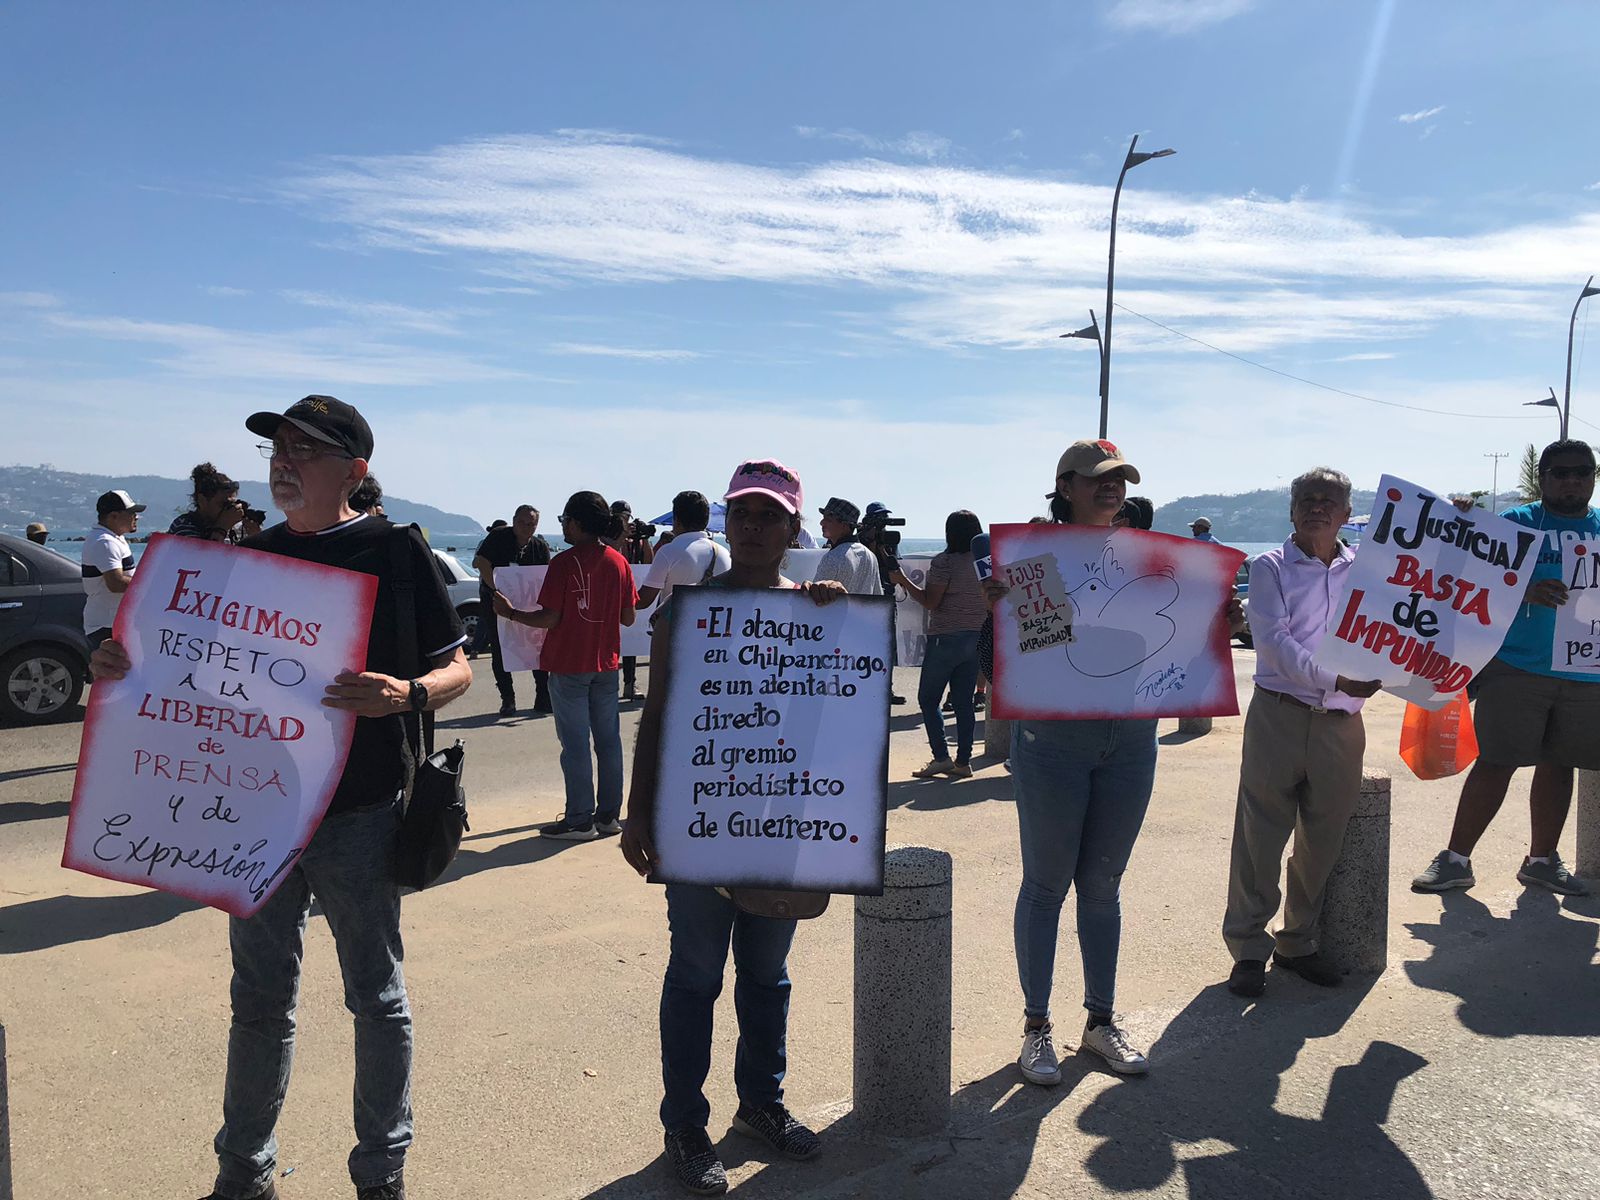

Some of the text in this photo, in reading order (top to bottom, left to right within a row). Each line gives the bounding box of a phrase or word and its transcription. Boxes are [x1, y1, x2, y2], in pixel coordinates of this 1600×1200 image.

[165, 568, 322, 647] EXIGIMOS
[1021, 581, 1045, 599] TI
[1387, 554, 1491, 626] BASTA
[742, 608, 825, 646] ataque
[1022, 611, 1062, 632] BASTA
[1036, 625, 1051, 634] de
[1392, 592, 1440, 637] de
[158, 629, 306, 687] RESPETO
[1335, 589, 1473, 694] IMPUNIDAD
[703, 648, 728, 664] en
[738, 644, 887, 679] Chilpancingo,
[179, 673, 249, 701] A LA
[700, 673, 856, 697] es un atentado
[138, 694, 305, 741] LIBERTAD
[693, 702, 781, 732] directo
[198, 737, 225, 755] de
[692, 738, 797, 772] al gremio
[134, 749, 287, 797] PRENSA
[693, 770, 845, 805] periodístico
[202, 796, 240, 823] de
[688, 811, 859, 843] de Guerrero.
[93, 814, 302, 903] Expresión!
